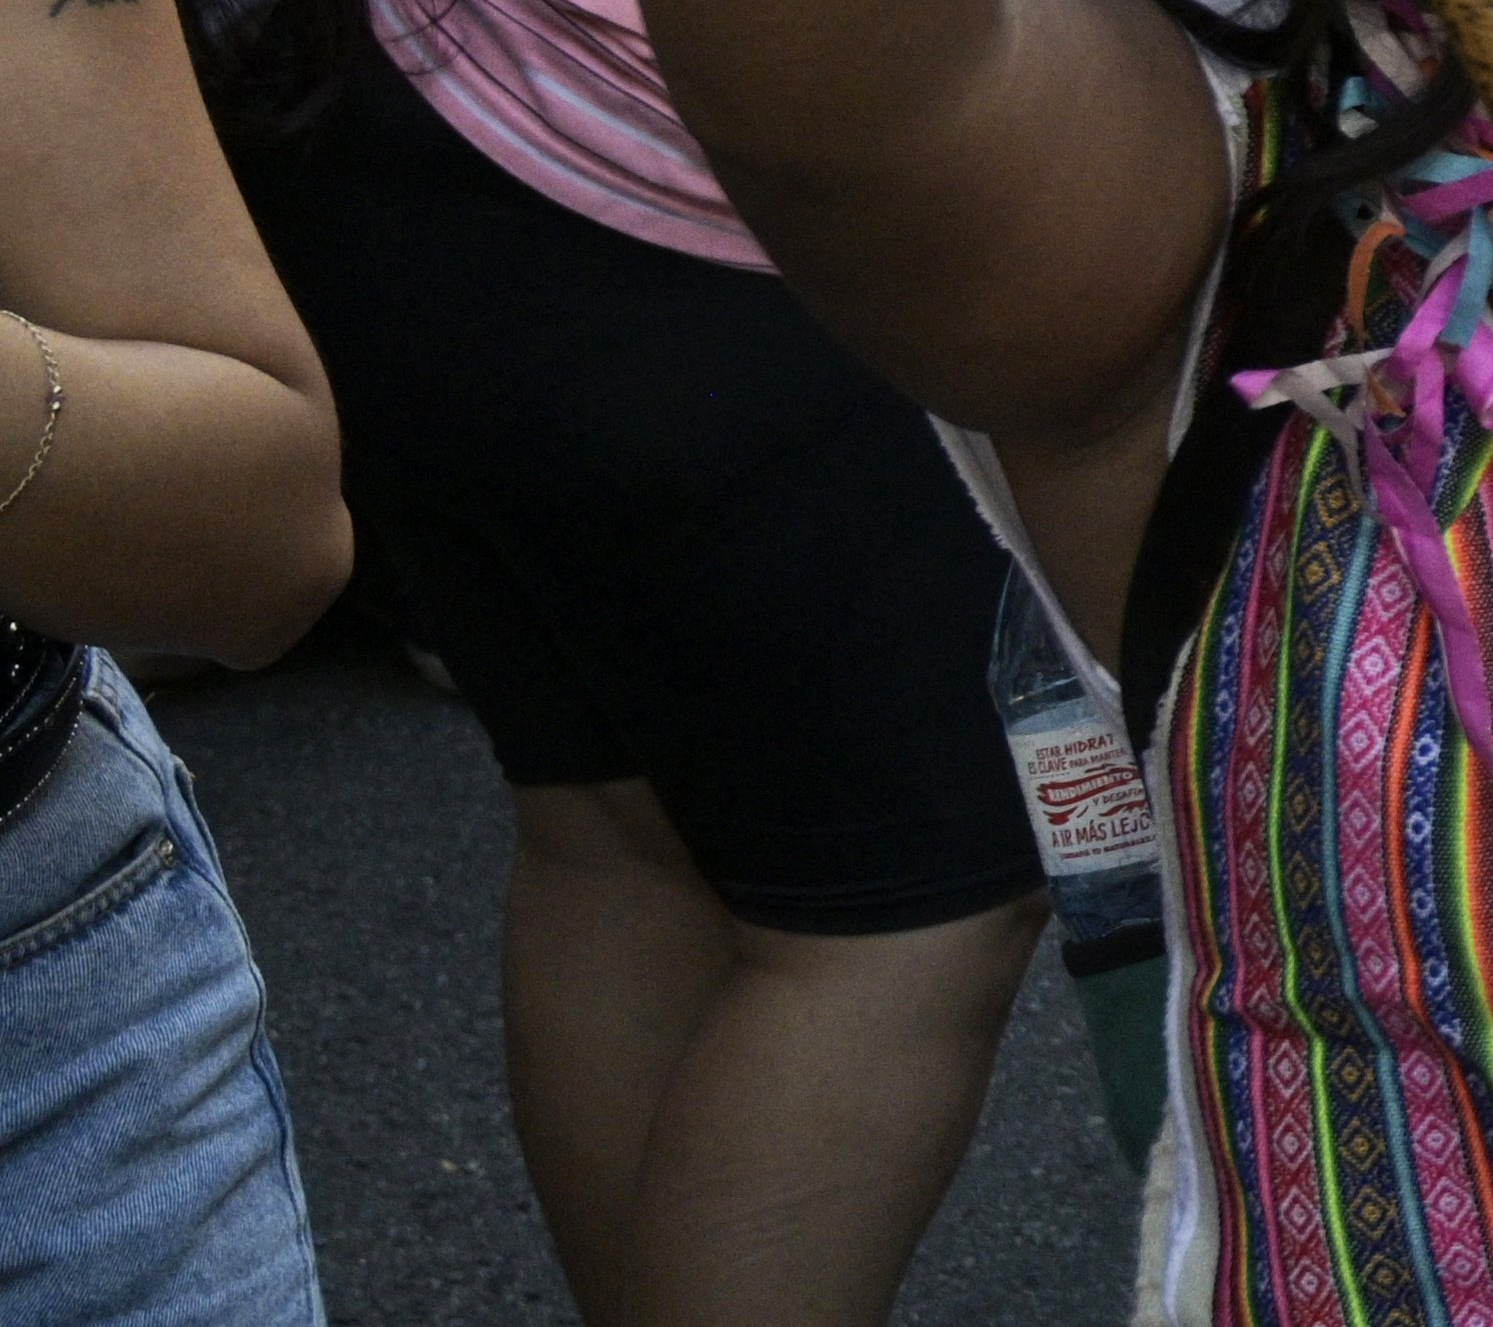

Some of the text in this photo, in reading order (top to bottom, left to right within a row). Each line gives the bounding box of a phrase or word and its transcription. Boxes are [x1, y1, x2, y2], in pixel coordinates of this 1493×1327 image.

[1036, 746, 1061, 760] ESTAR
[1038, 757, 1068, 774] CLAVE
[1061, 829, 1073, 847] IR
[1075, 819, 1107, 845] MÁS
